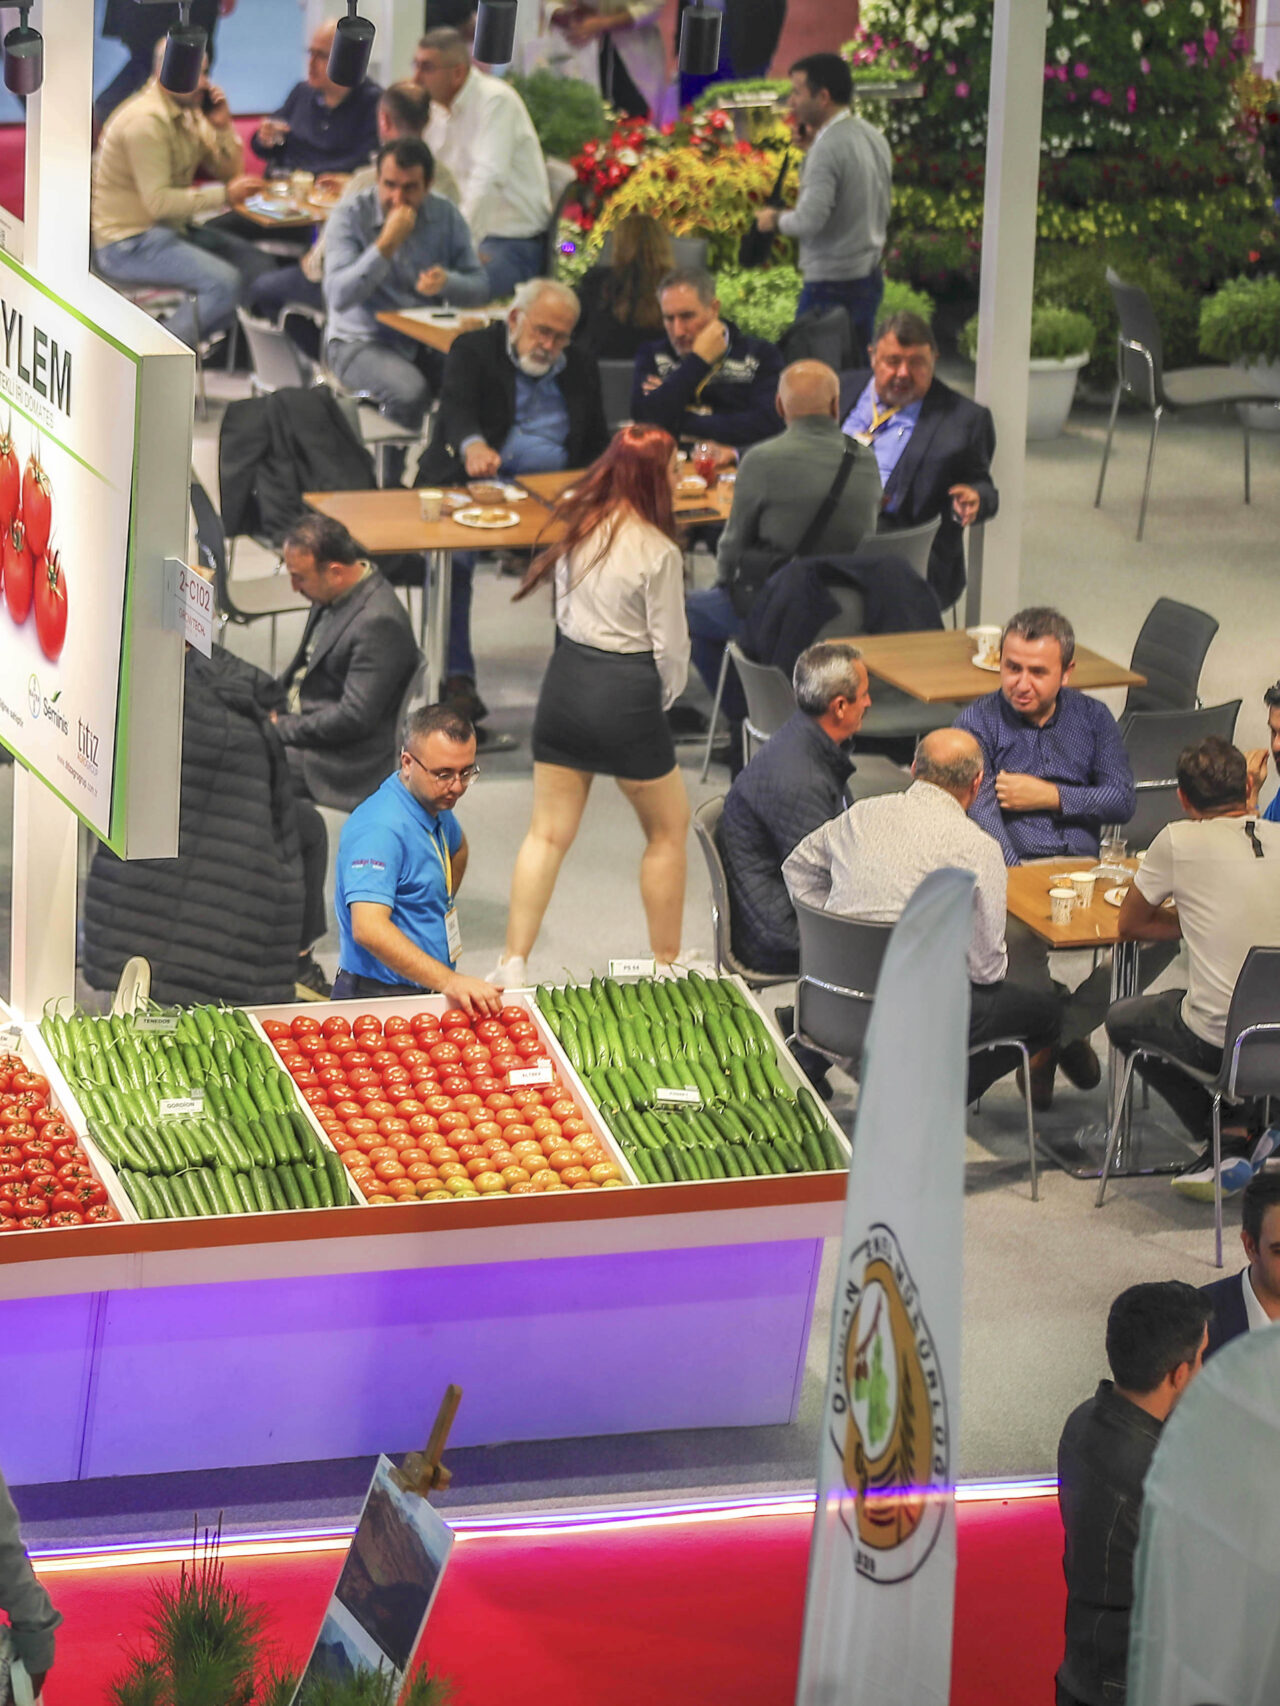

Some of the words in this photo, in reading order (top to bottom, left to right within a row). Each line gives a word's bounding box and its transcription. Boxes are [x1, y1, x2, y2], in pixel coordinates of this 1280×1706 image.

[24, 391, 54, 429] DOMATES
[179, 569, 210, 612] 2-C102
[42, 697, 69, 736] Seminis
[77, 715, 99, 768] titiz
